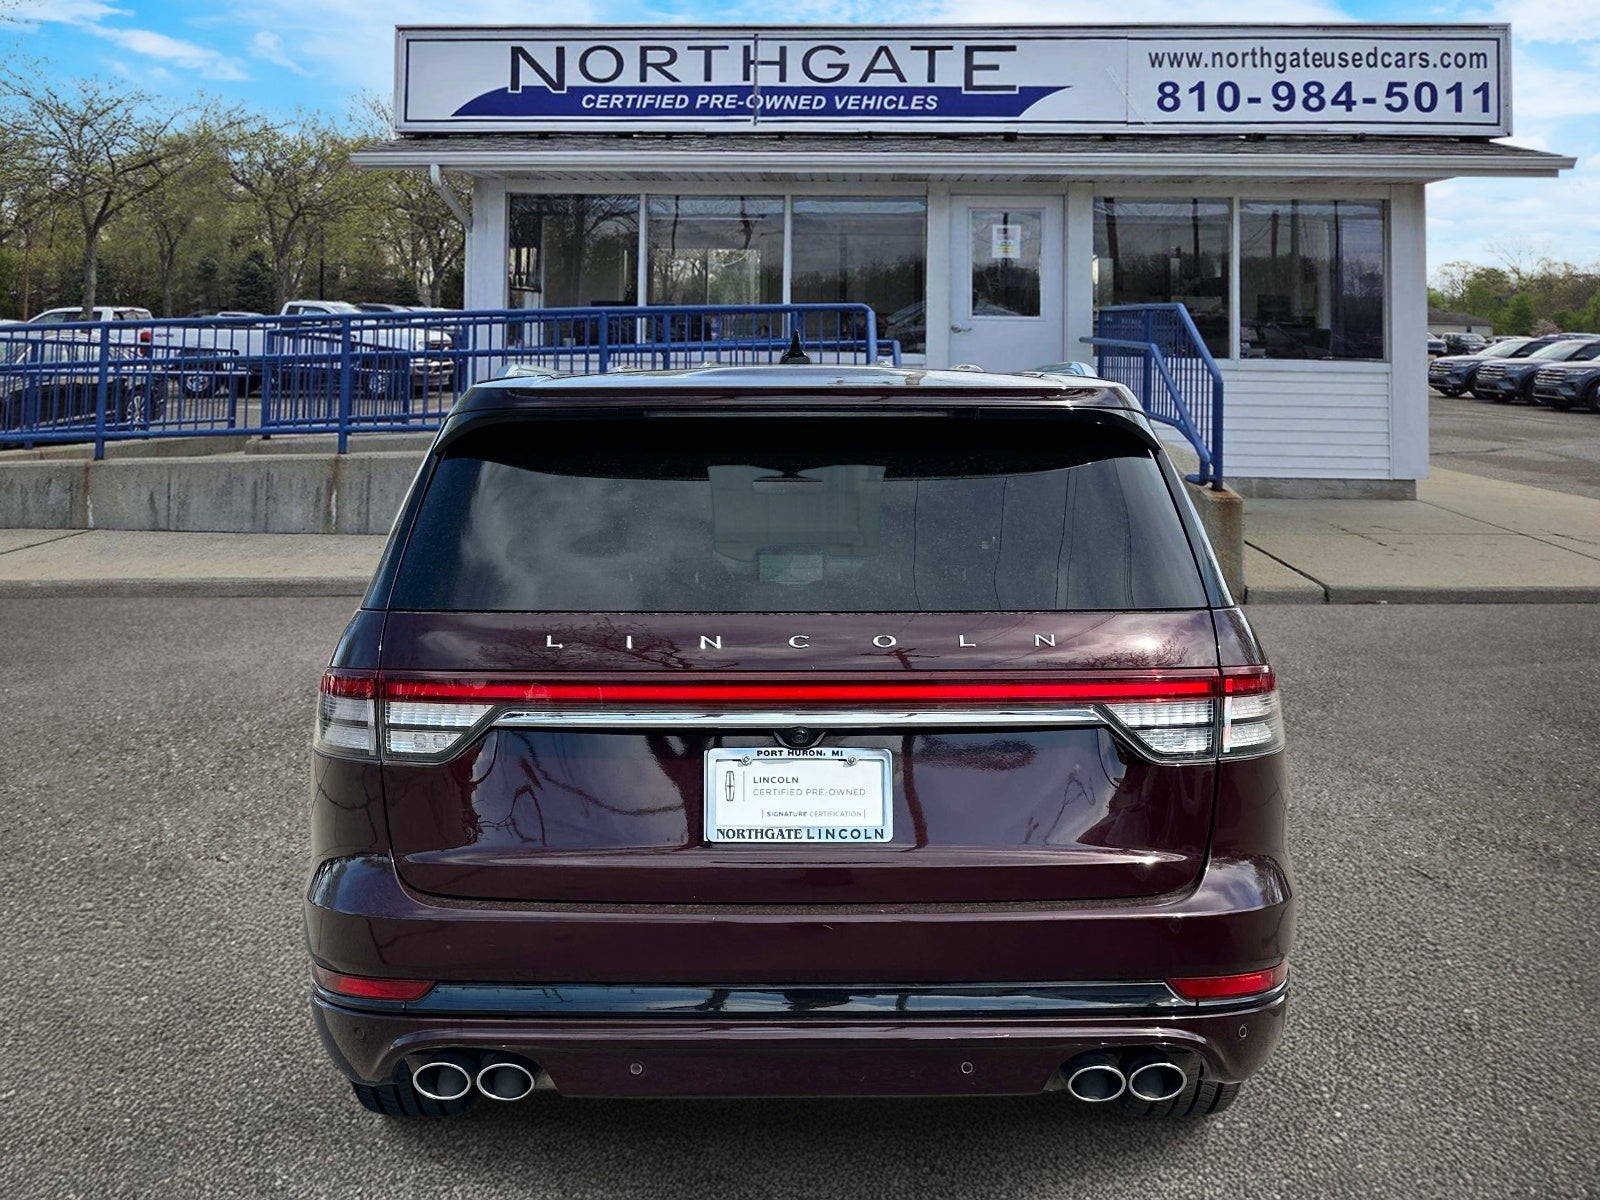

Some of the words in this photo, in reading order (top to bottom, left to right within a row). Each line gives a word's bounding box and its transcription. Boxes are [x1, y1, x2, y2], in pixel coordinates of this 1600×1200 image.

[509, 44, 1017, 92] NORTHGATE
[1148, 46, 1488, 73] www.northgateusedcars.com
[581, 94, 689, 110] CERTIFIED
[695, 94, 826, 110] PRE-OWNED
[834, 94, 939, 110] VEHICLES
[1156, 80, 1491, 113] 810-984-5011
[545, 633, 1057, 651] LINCOLN
[753, 776, 799, 784] LINCOLN
[752, 788, 803, 796] CERTIFIED
[805, 788, 866, 796] PRE-OWNED
[716, 828, 803, 840] NORTHGATE
[806, 828, 885, 840] LINCOLN
